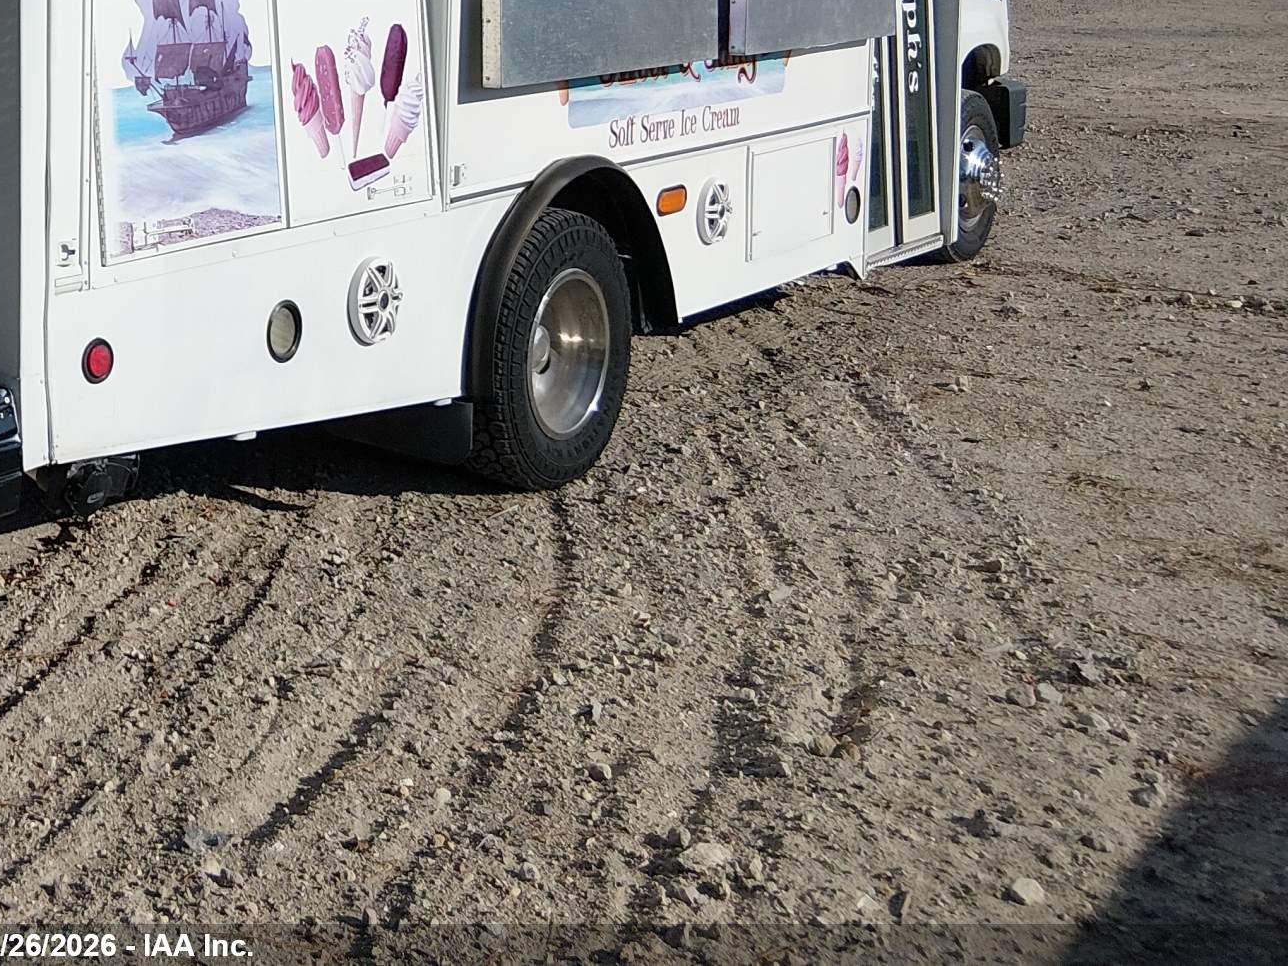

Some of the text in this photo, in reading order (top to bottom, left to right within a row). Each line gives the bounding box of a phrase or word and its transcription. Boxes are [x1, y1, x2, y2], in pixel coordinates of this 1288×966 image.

[608, 105, 740, 148] Soft Serve Ice Cream
